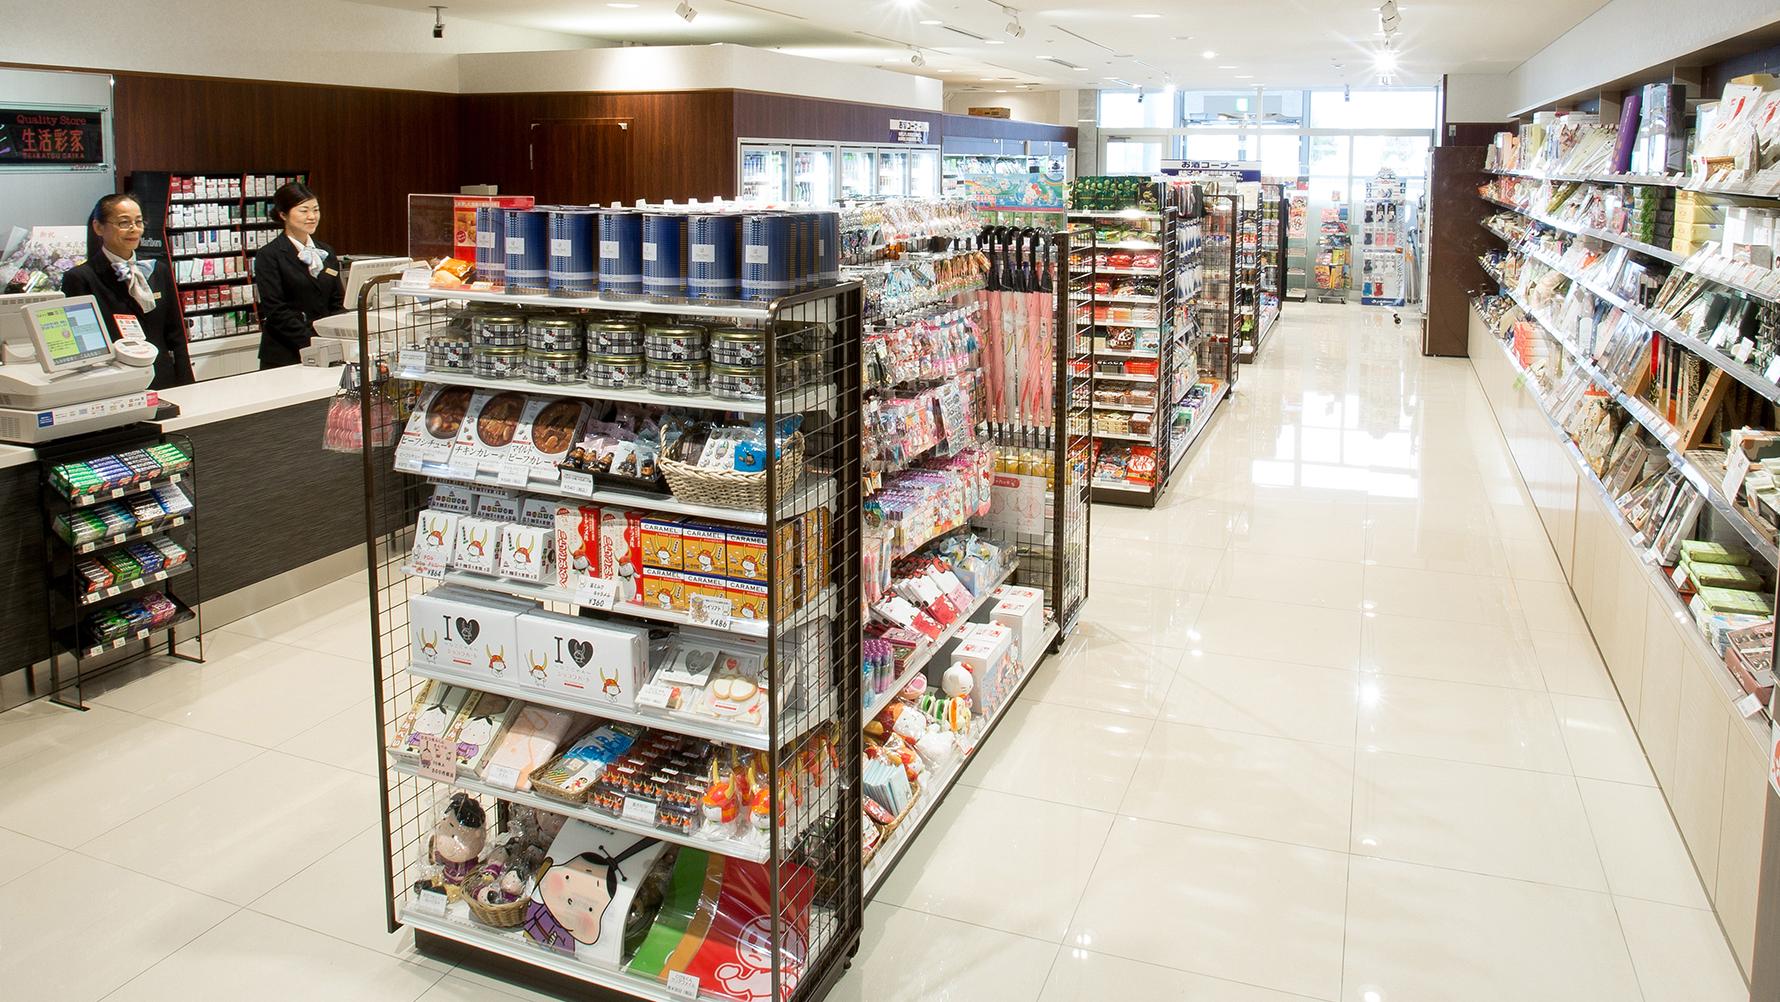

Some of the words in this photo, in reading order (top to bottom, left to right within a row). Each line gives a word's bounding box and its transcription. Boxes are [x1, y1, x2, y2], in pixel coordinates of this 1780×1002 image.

[16, 114, 58, 126] Quality
[60, 115, 87, 125] Store
[22, 128, 85, 152] 生活彩家
[1181, 161, 1240, 169] お酒コーナー
[400, 436, 447, 449] ビーフシチュー
[455, 446, 499, 458] チキンカレー
[512, 445, 535, 454] マイルド
[508, 454, 551, 465] ビーフカレー
[644, 523, 679, 534] CARAMEL
[686, 530, 721, 539] CARAMEL
[730, 535, 767, 544] CARAMEL
[427, 569, 442, 577] ¥864
[646, 568, 681, 579] CARAMEL
[687, 576, 722, 586] CARAMEL
[730, 582, 766, 592] CARAMEL
[588, 598, 605, 607] ¥360
[443, 615, 452, 641] I
[710, 619, 728, 629] ¥486
[554, 636, 563, 664] I
